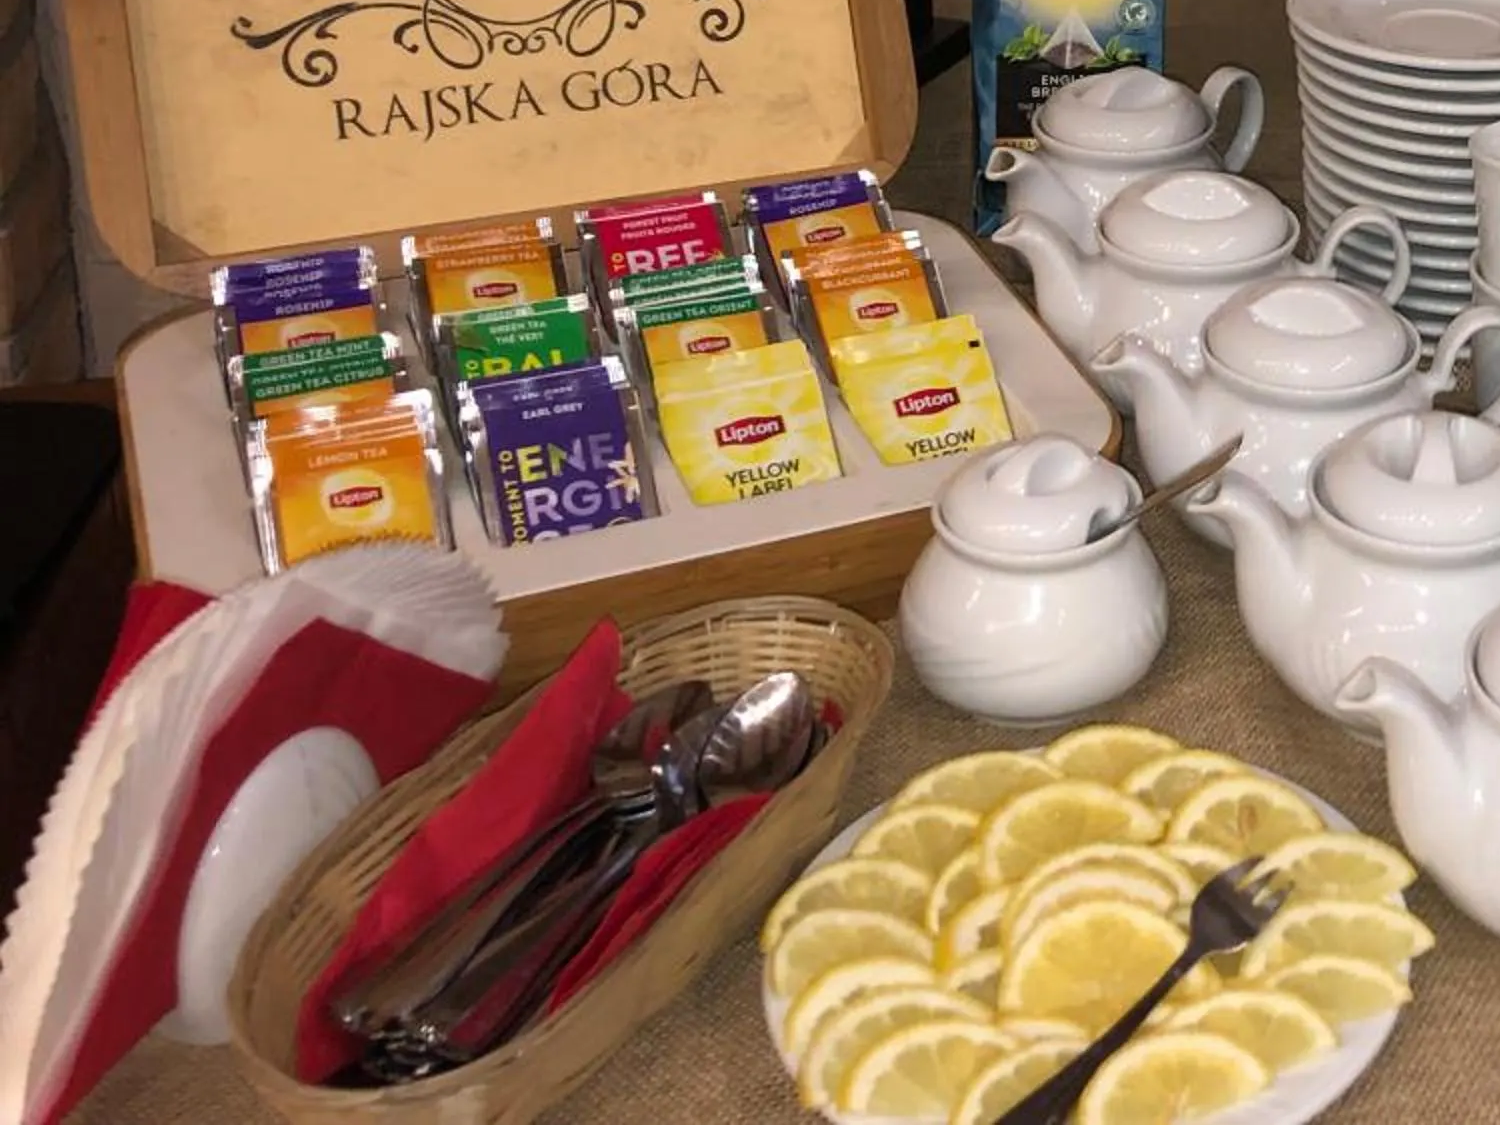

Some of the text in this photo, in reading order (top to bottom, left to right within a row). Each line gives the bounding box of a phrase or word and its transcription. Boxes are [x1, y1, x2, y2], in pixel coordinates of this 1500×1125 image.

[332, 59, 724, 143] RAJSKA GÓRA
[661, 212, 689, 225] FRUIT
[519, 250, 540, 262] TEA
[275, 298, 335, 316] ROSEHIP
[642, 300, 752, 324] GREEN TEA ORIENT
[489, 320, 547, 335] GREEN TEA
[518, 331, 545, 343] VERT
[308, 346, 334, 360] TEA
[255, 377, 302, 399] GREEN
[303, 373, 332, 389] TEA
[333, 365, 386, 386] CITRUS
[521, 401, 584, 421] EARL GREY
[898, 390, 956, 415] Lipton
[720, 418, 781, 444] Lipton
[905, 427, 977, 458] YELLOW
[307, 446, 389, 470] LEMON TEA
[498, 449, 514, 474] TO
[516, 431, 616, 484] ENE
[725, 458, 801, 489] YELLOW
[332, 487, 381, 508] Lipton
